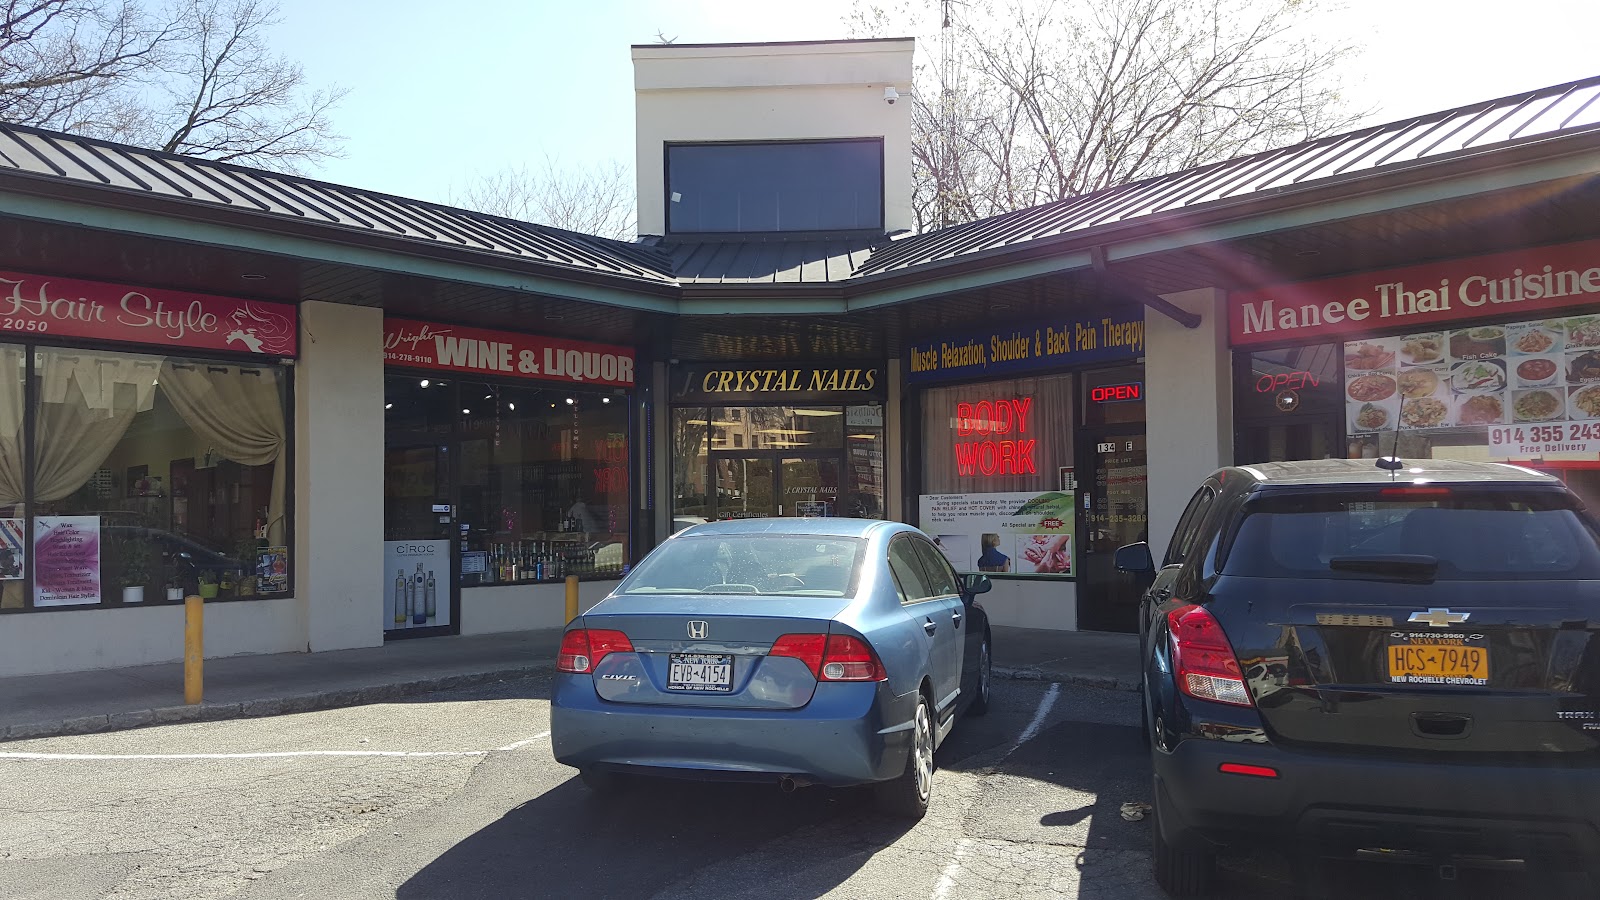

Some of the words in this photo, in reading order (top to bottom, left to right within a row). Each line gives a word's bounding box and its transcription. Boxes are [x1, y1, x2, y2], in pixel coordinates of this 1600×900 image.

[0, 278, 106, 322] Hair
[116, 291, 218, 339] Style
[1242, 299, 1370, 335] Manee
[1374, 279, 1451, 318] Thai
[1458, 264, 1600, 308] Cuisine
[384, 325, 452, 351] Wright
[911, 346, 938, 373] Muscle
[941, 338, 987, 369] Relaxation,
[990, 331, 1030, 362] Shoulder
[1035, 329, 1042, 356] &
[1046, 325, 1070, 355] Back
[1075, 321, 1097, 351] Pain
[1102, 318, 1144, 352] Therapy
[434, 335, 513, 372] WINE
[518, 350, 539, 375] &
[543, 347, 634, 383] LIQUOR
[677, 371, 695, 397] J.
[702, 370, 802, 392] CRYSTAL
[807, 369, 877, 391] NAILS
[1091, 385, 1139, 401] OPEN
[1256, 372, 1320, 393] OPEN
[957, 398, 1031, 436] BODY
[1492, 427, 1524, 446] 914
[1530, 425, 1563, 442] 355
[1569, 422, 1600, 440] 243
[955, 440, 1036, 476] WORK
[1098, 444, 1115, 452] 134
[1126, 442, 1131, 450] E
[1545, 443, 1587, 454] Delivery
[1395, 648, 1425, 671] HCS
[1438, 648, 1480, 672] 7949
[673, 665, 693, 682] EVB
[701, 665, 726, 683] 4154
[1409, 676, 1445, 684] ROCHELLE
[1446, 677, 1487, 685] CHEVROLET
[1556, 711, 1594, 719] TRAX
